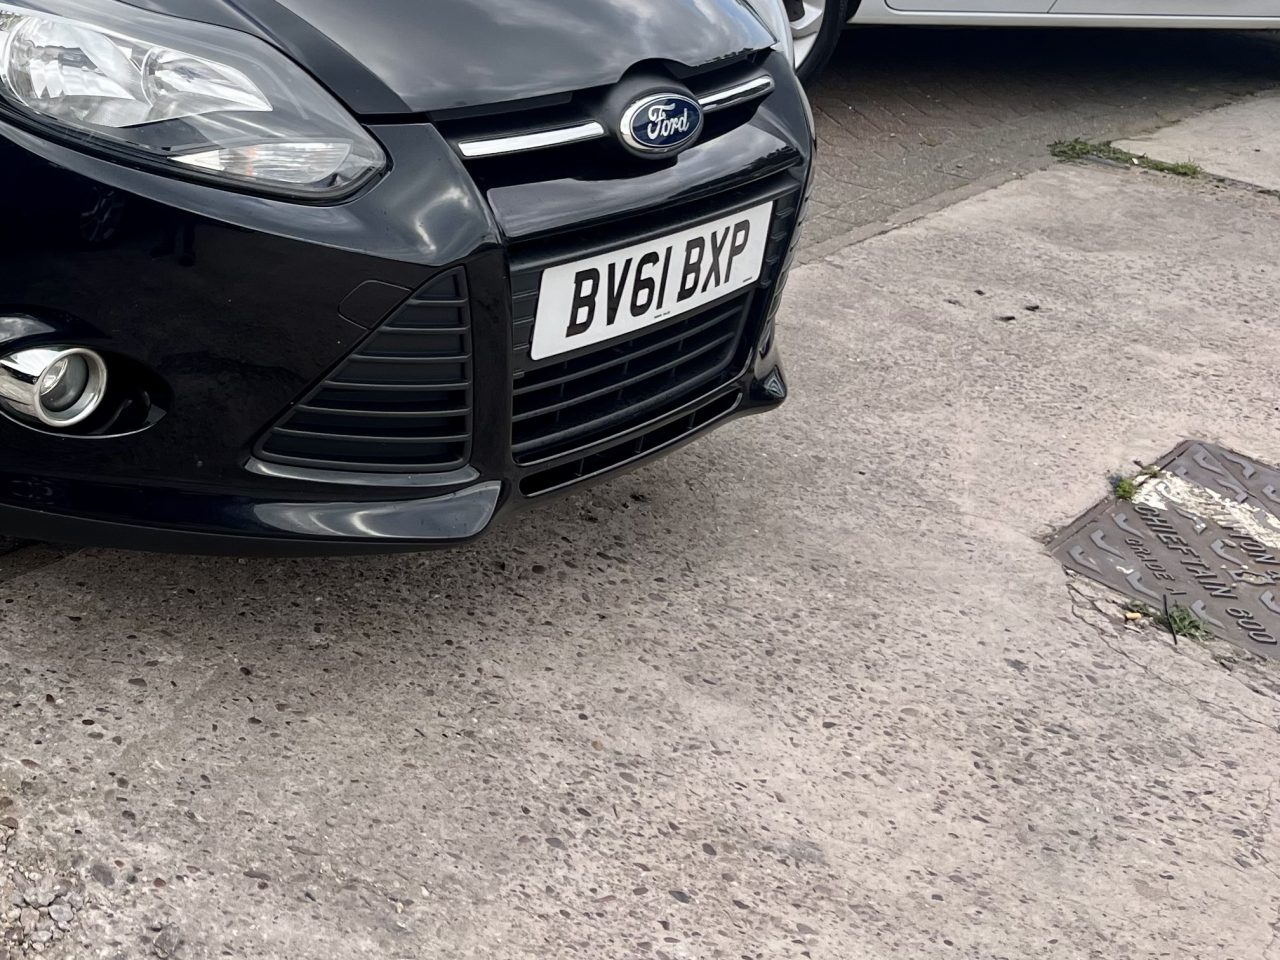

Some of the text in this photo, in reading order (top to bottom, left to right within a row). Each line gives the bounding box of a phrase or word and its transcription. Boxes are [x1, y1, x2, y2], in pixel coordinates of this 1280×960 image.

[646, 103, 690, 140] Ford
[565, 219, 751, 338] BV61 BXP
[1133, 505, 1278, 645] CHIEFTAIN 600
